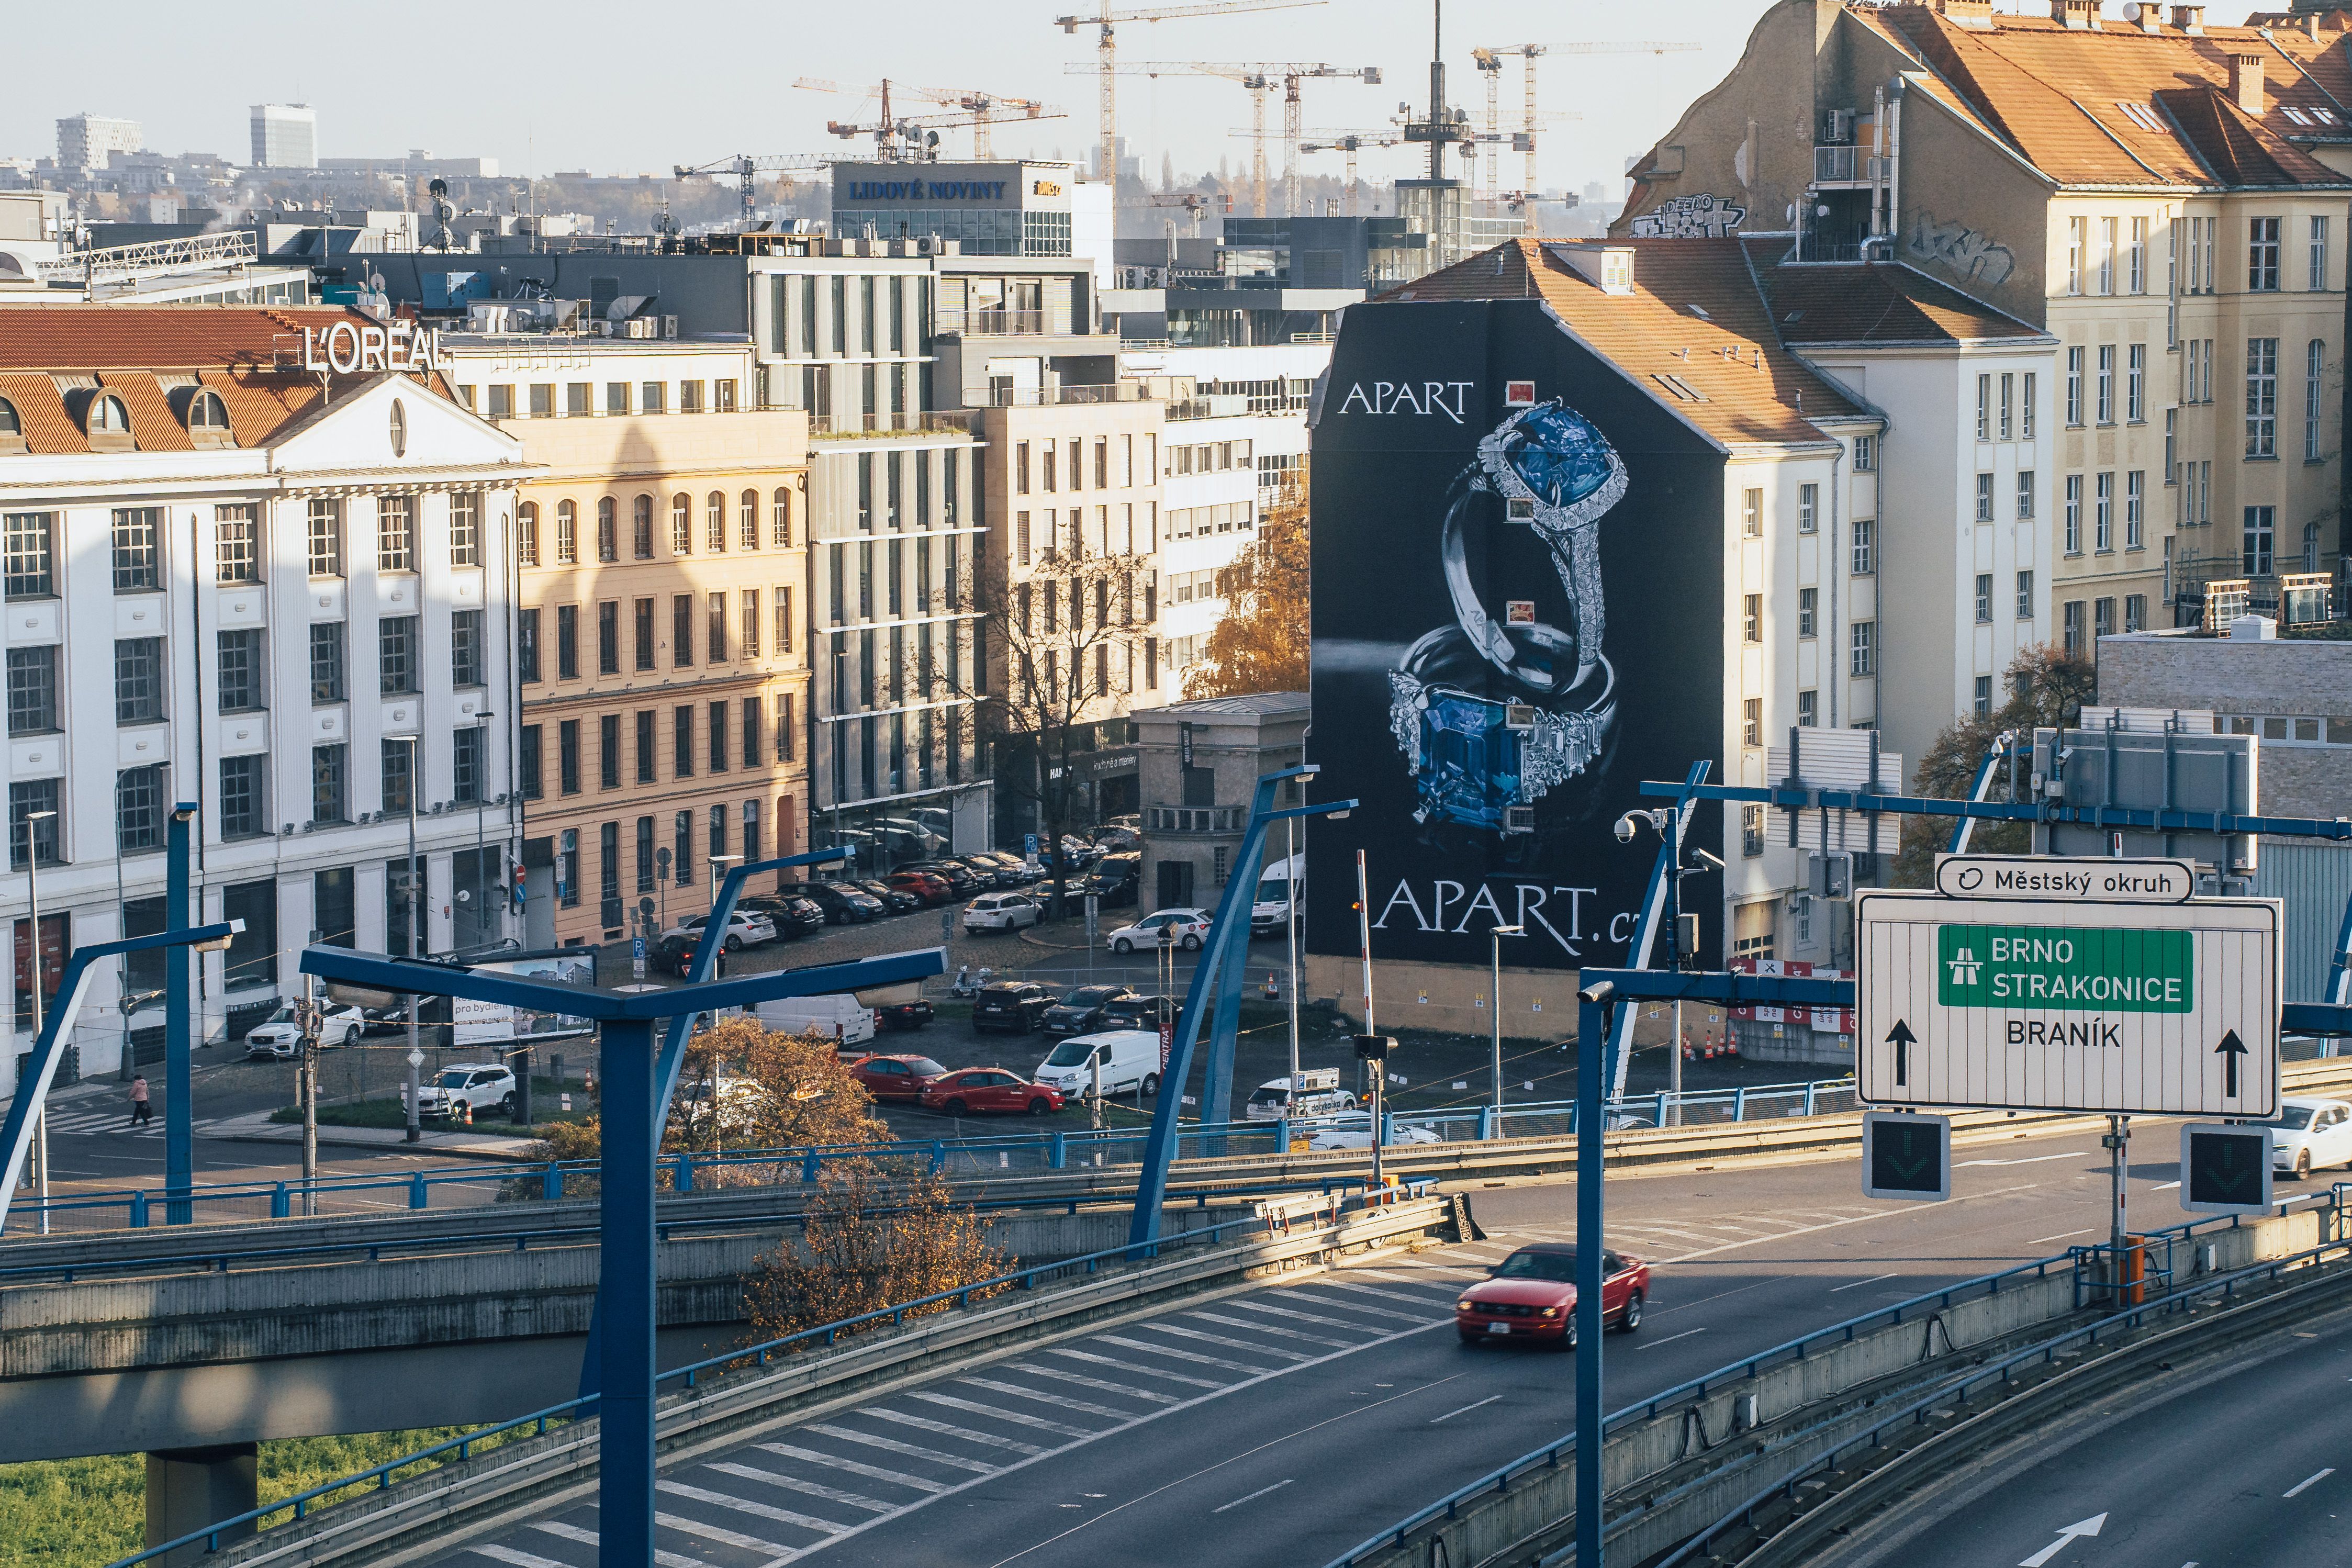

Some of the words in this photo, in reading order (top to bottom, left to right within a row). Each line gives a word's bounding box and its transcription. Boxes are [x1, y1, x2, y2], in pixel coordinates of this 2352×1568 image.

[849, 177, 923, 200] LIDOVÉ
[927, 181, 1007, 200] NOVINY
[1666, 195, 1712, 213] DEEBO
[1337, 381, 1474, 424] APART
[1994, 869, 2091, 896] Městský
[2103, 872, 2172, 893] okruh
[1991, 937, 2074, 964] BRNO
[1992, 973, 2182, 1003] STRAKONICE
[455, 1005, 471, 1015] pro
[2007, 1017, 2121, 1048] BRANÍK
